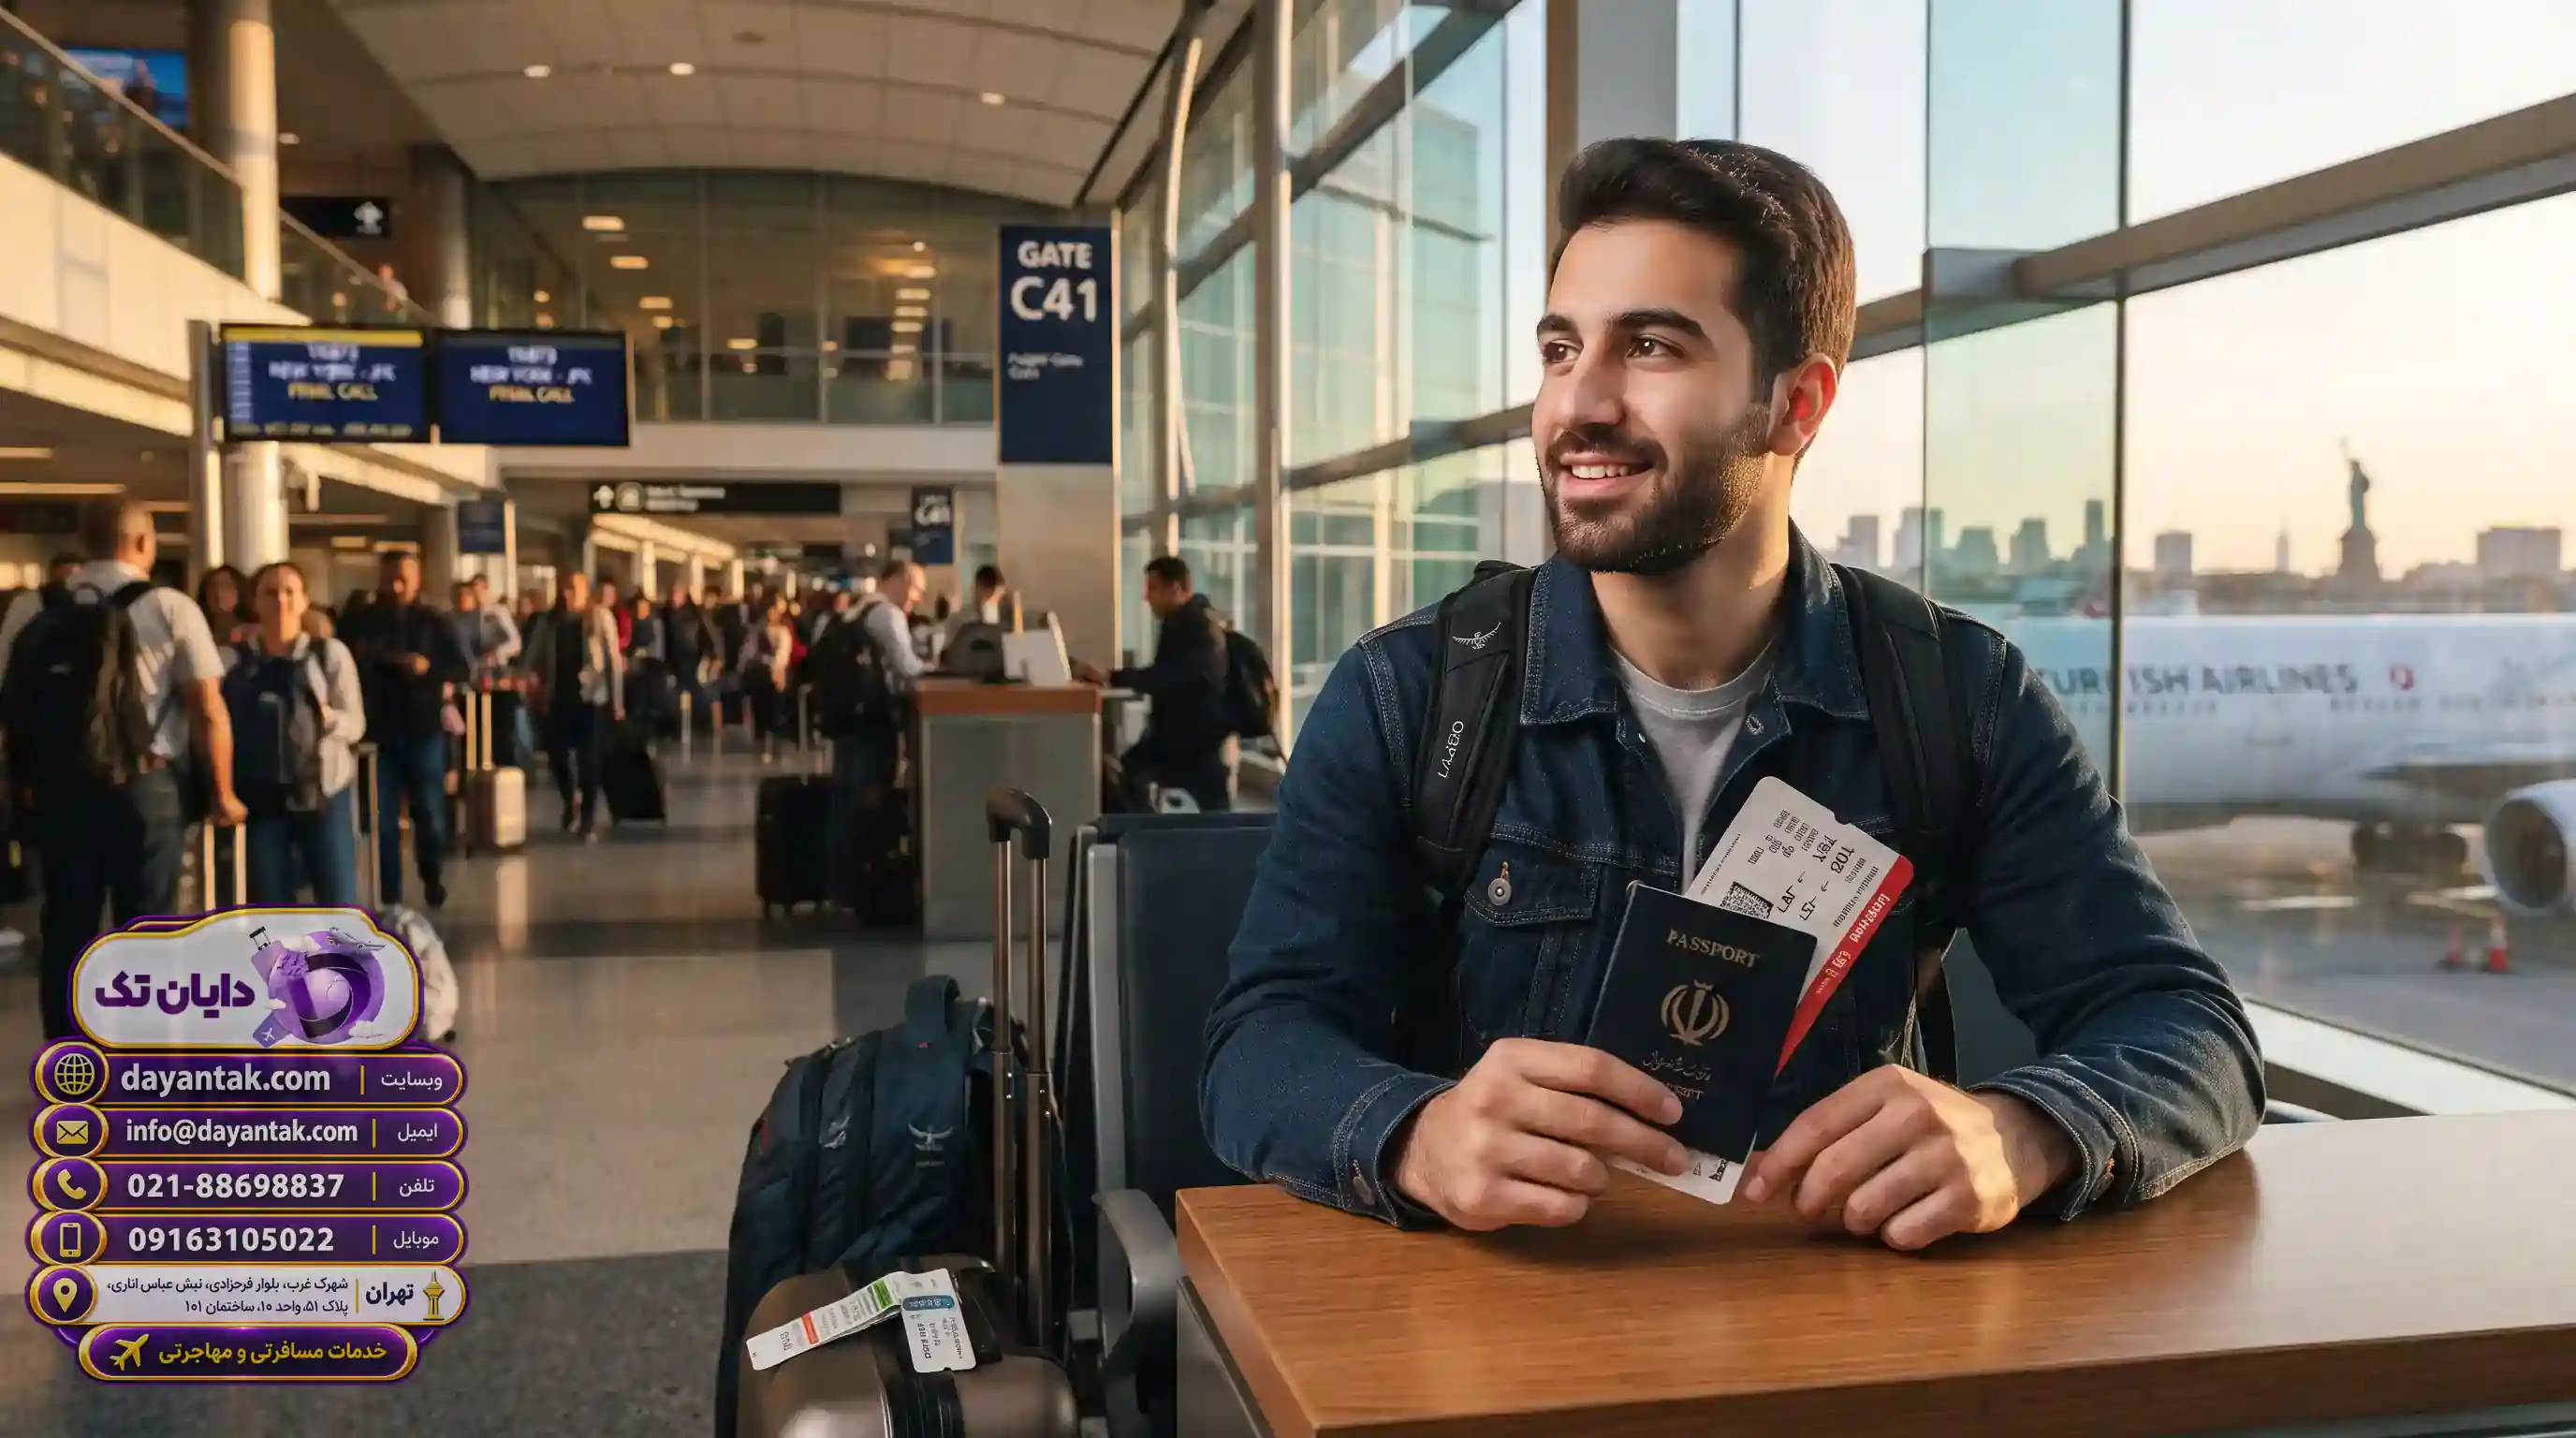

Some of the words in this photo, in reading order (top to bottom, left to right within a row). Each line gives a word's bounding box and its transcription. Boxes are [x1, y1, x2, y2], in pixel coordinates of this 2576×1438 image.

[1017, 241, 1092, 270] GATE
[1011, 276, 1097, 322] C41
[1666, 928, 1761, 968] PASSPORT
